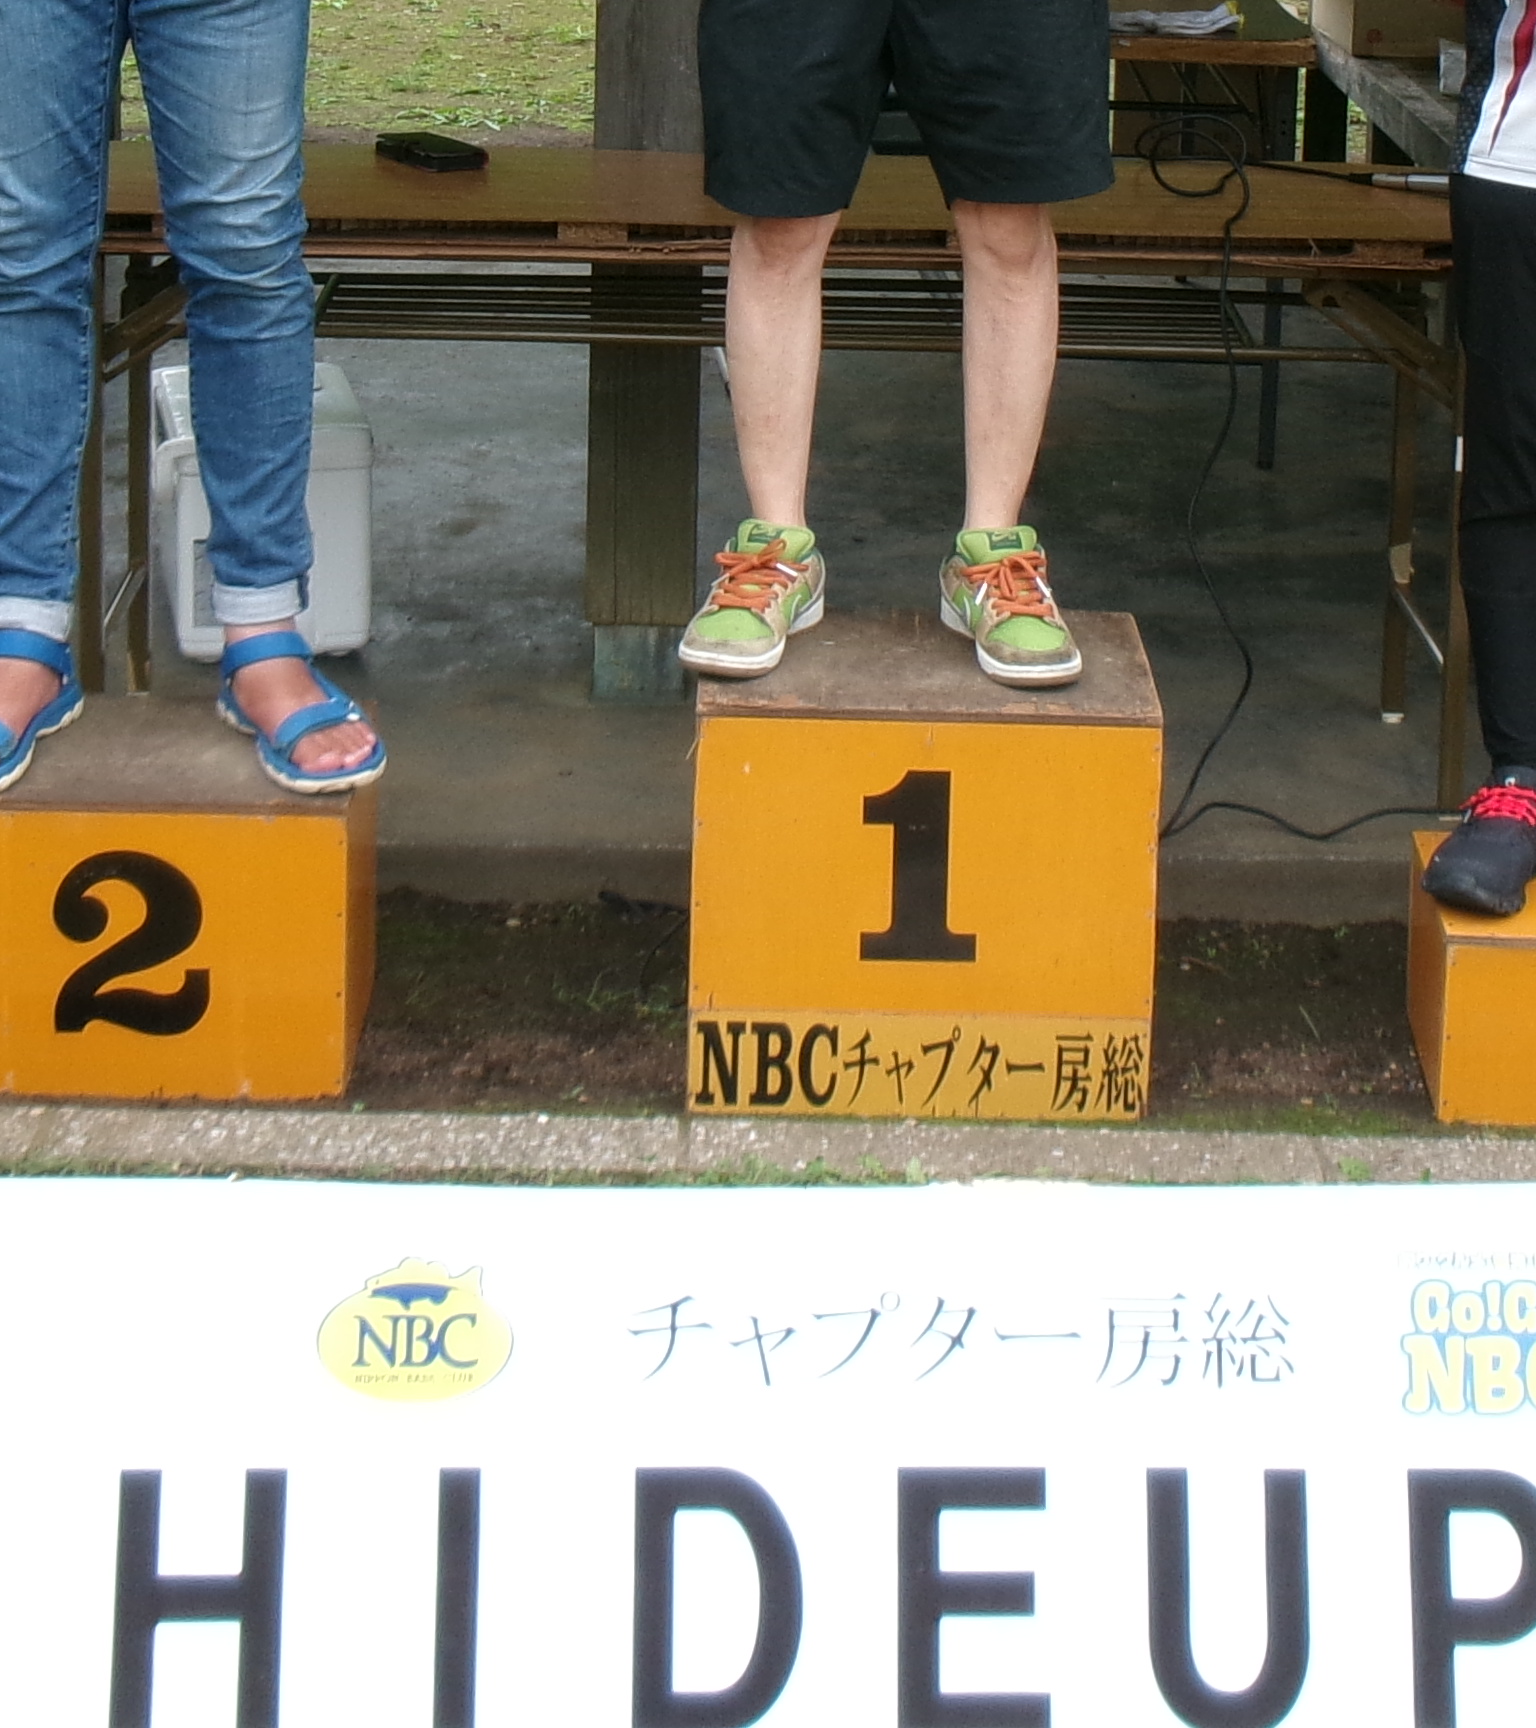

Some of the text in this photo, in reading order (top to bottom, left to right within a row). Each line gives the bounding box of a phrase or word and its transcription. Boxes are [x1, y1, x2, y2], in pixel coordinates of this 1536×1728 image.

[859, 770, 977, 963] 1
[52, 850, 211, 1037] 2
[351, 1313, 479, 1369] NBC
[626, 1290, 1294, 1388] チャプター房総
